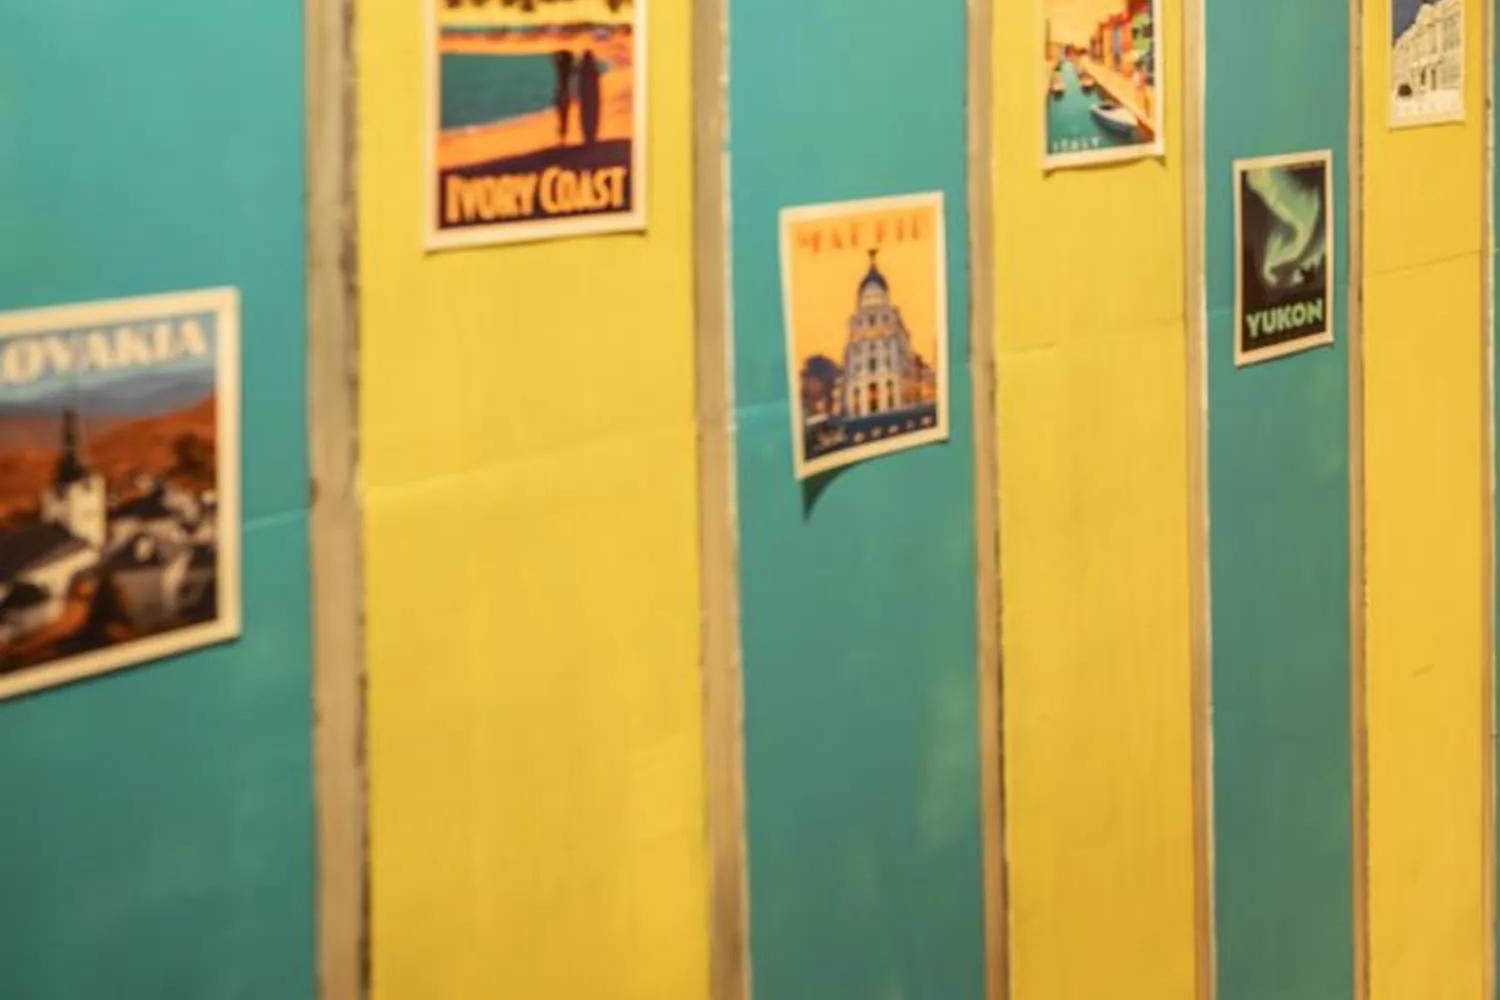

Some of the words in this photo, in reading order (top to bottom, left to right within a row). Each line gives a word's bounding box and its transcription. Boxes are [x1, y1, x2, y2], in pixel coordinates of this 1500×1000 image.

[446, 174, 537, 222] IVORY
[539, 165, 627, 214] COAST
[1246, 298, 1322, 338] YUKON
